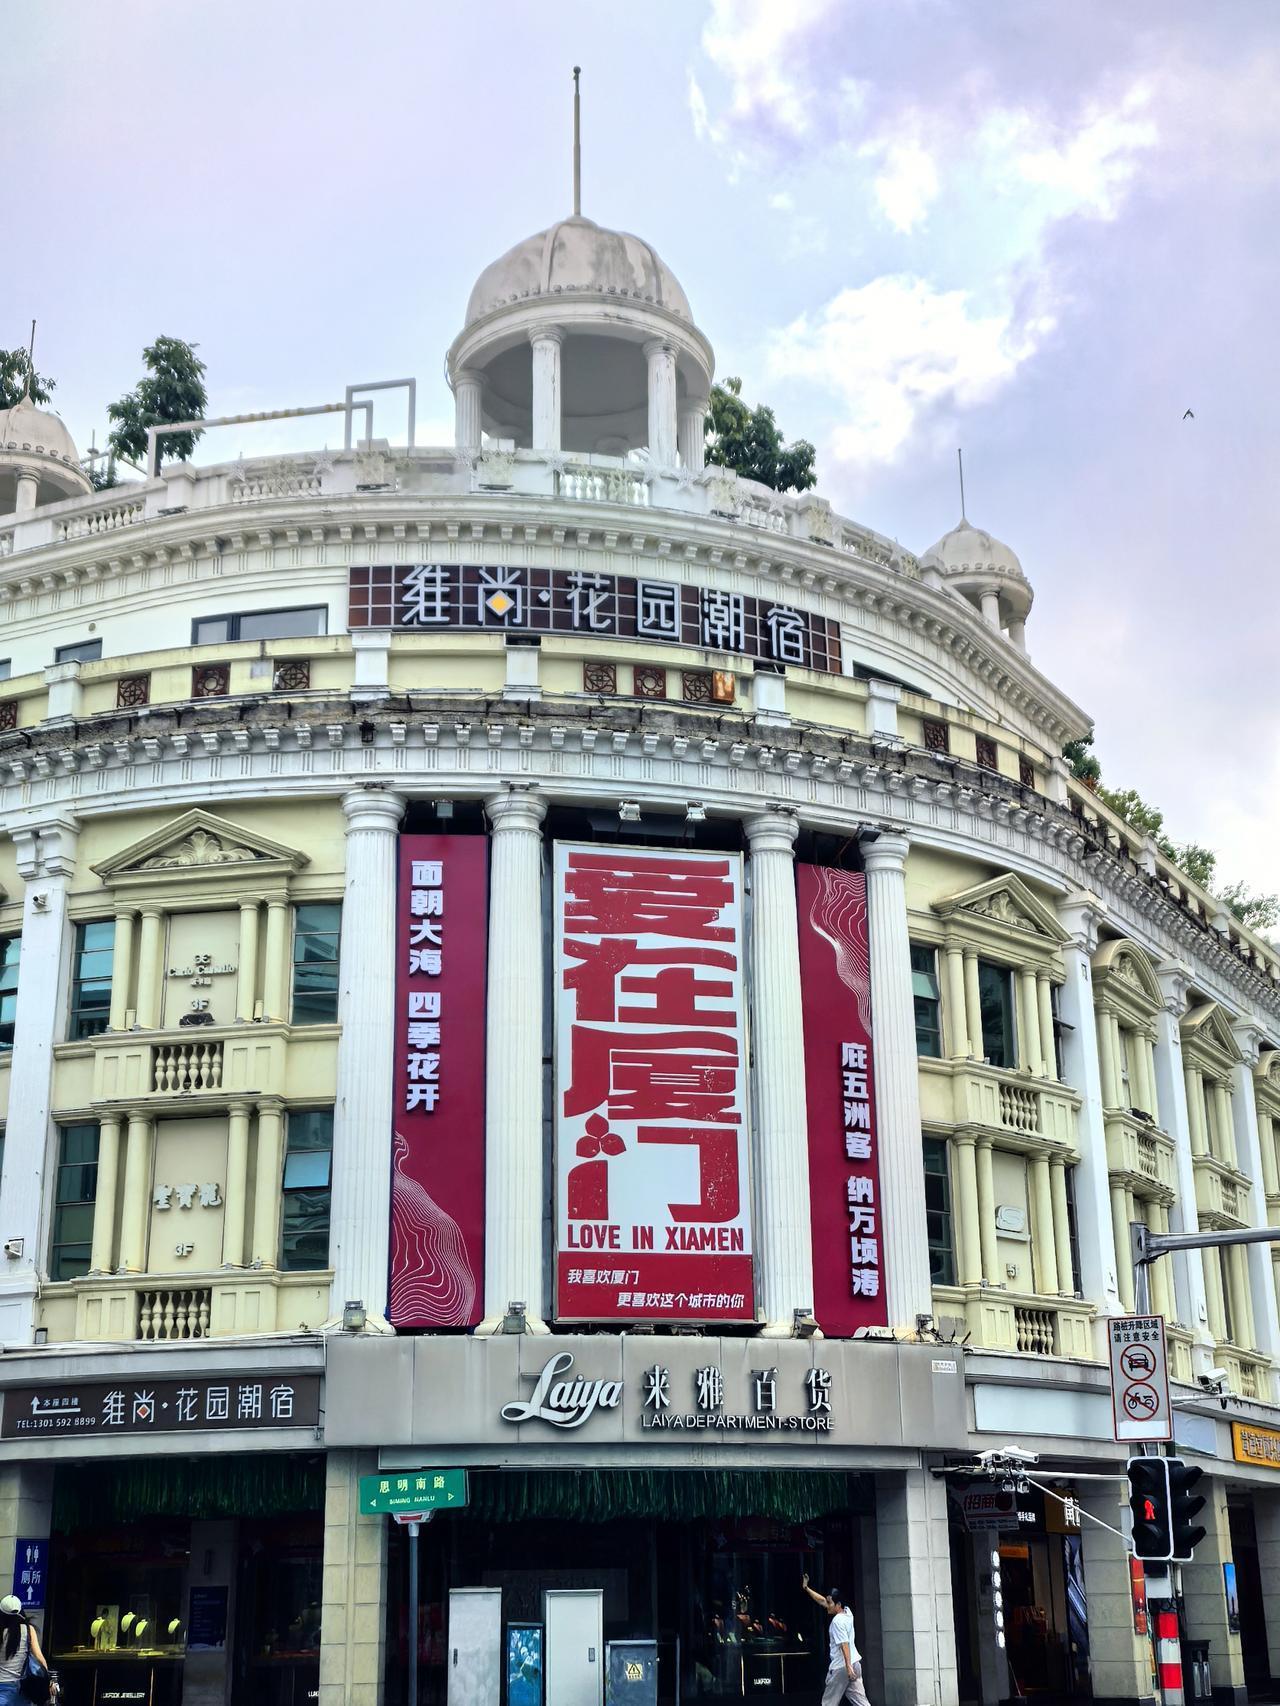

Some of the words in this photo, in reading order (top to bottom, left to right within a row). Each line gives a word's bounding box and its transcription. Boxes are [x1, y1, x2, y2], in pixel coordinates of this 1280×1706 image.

[409, 860, 443, 976] 面朝大海
[564, 852, 742, 1223] 爱在厦门
[406, 992, 441, 1112] 四季花开
[842, 1042, 872, 1160] 庇五洲客
[567, 1223, 621, 1249] LOVE
[632, 1226, 653, 1250] IN
[665, 1227, 744, 1252] XIAMEN
[847, 1176, 879, 1297] 纳万顷涛
[567, 1268, 640, 1286] 我喜欢厦门
[616, 1291, 745, 1309] 更喜欢这个城市的你
[1113, 1319, 1159, 1331] 路桩升降区域
[1114, 1331, 1159, 1343] 请注意安全
[500, 1351, 625, 1428] Laiya
[644, 1364, 833, 1412] 来雅百货
[56, 1418, 72, 1427] 592
[74, 1416, 96, 1426] 8899
[641, 1413, 684, 1428] LAIYA
[379, 1476, 445, 1494] 思明南路
[20, 1570, 41, 1585] 厕所
